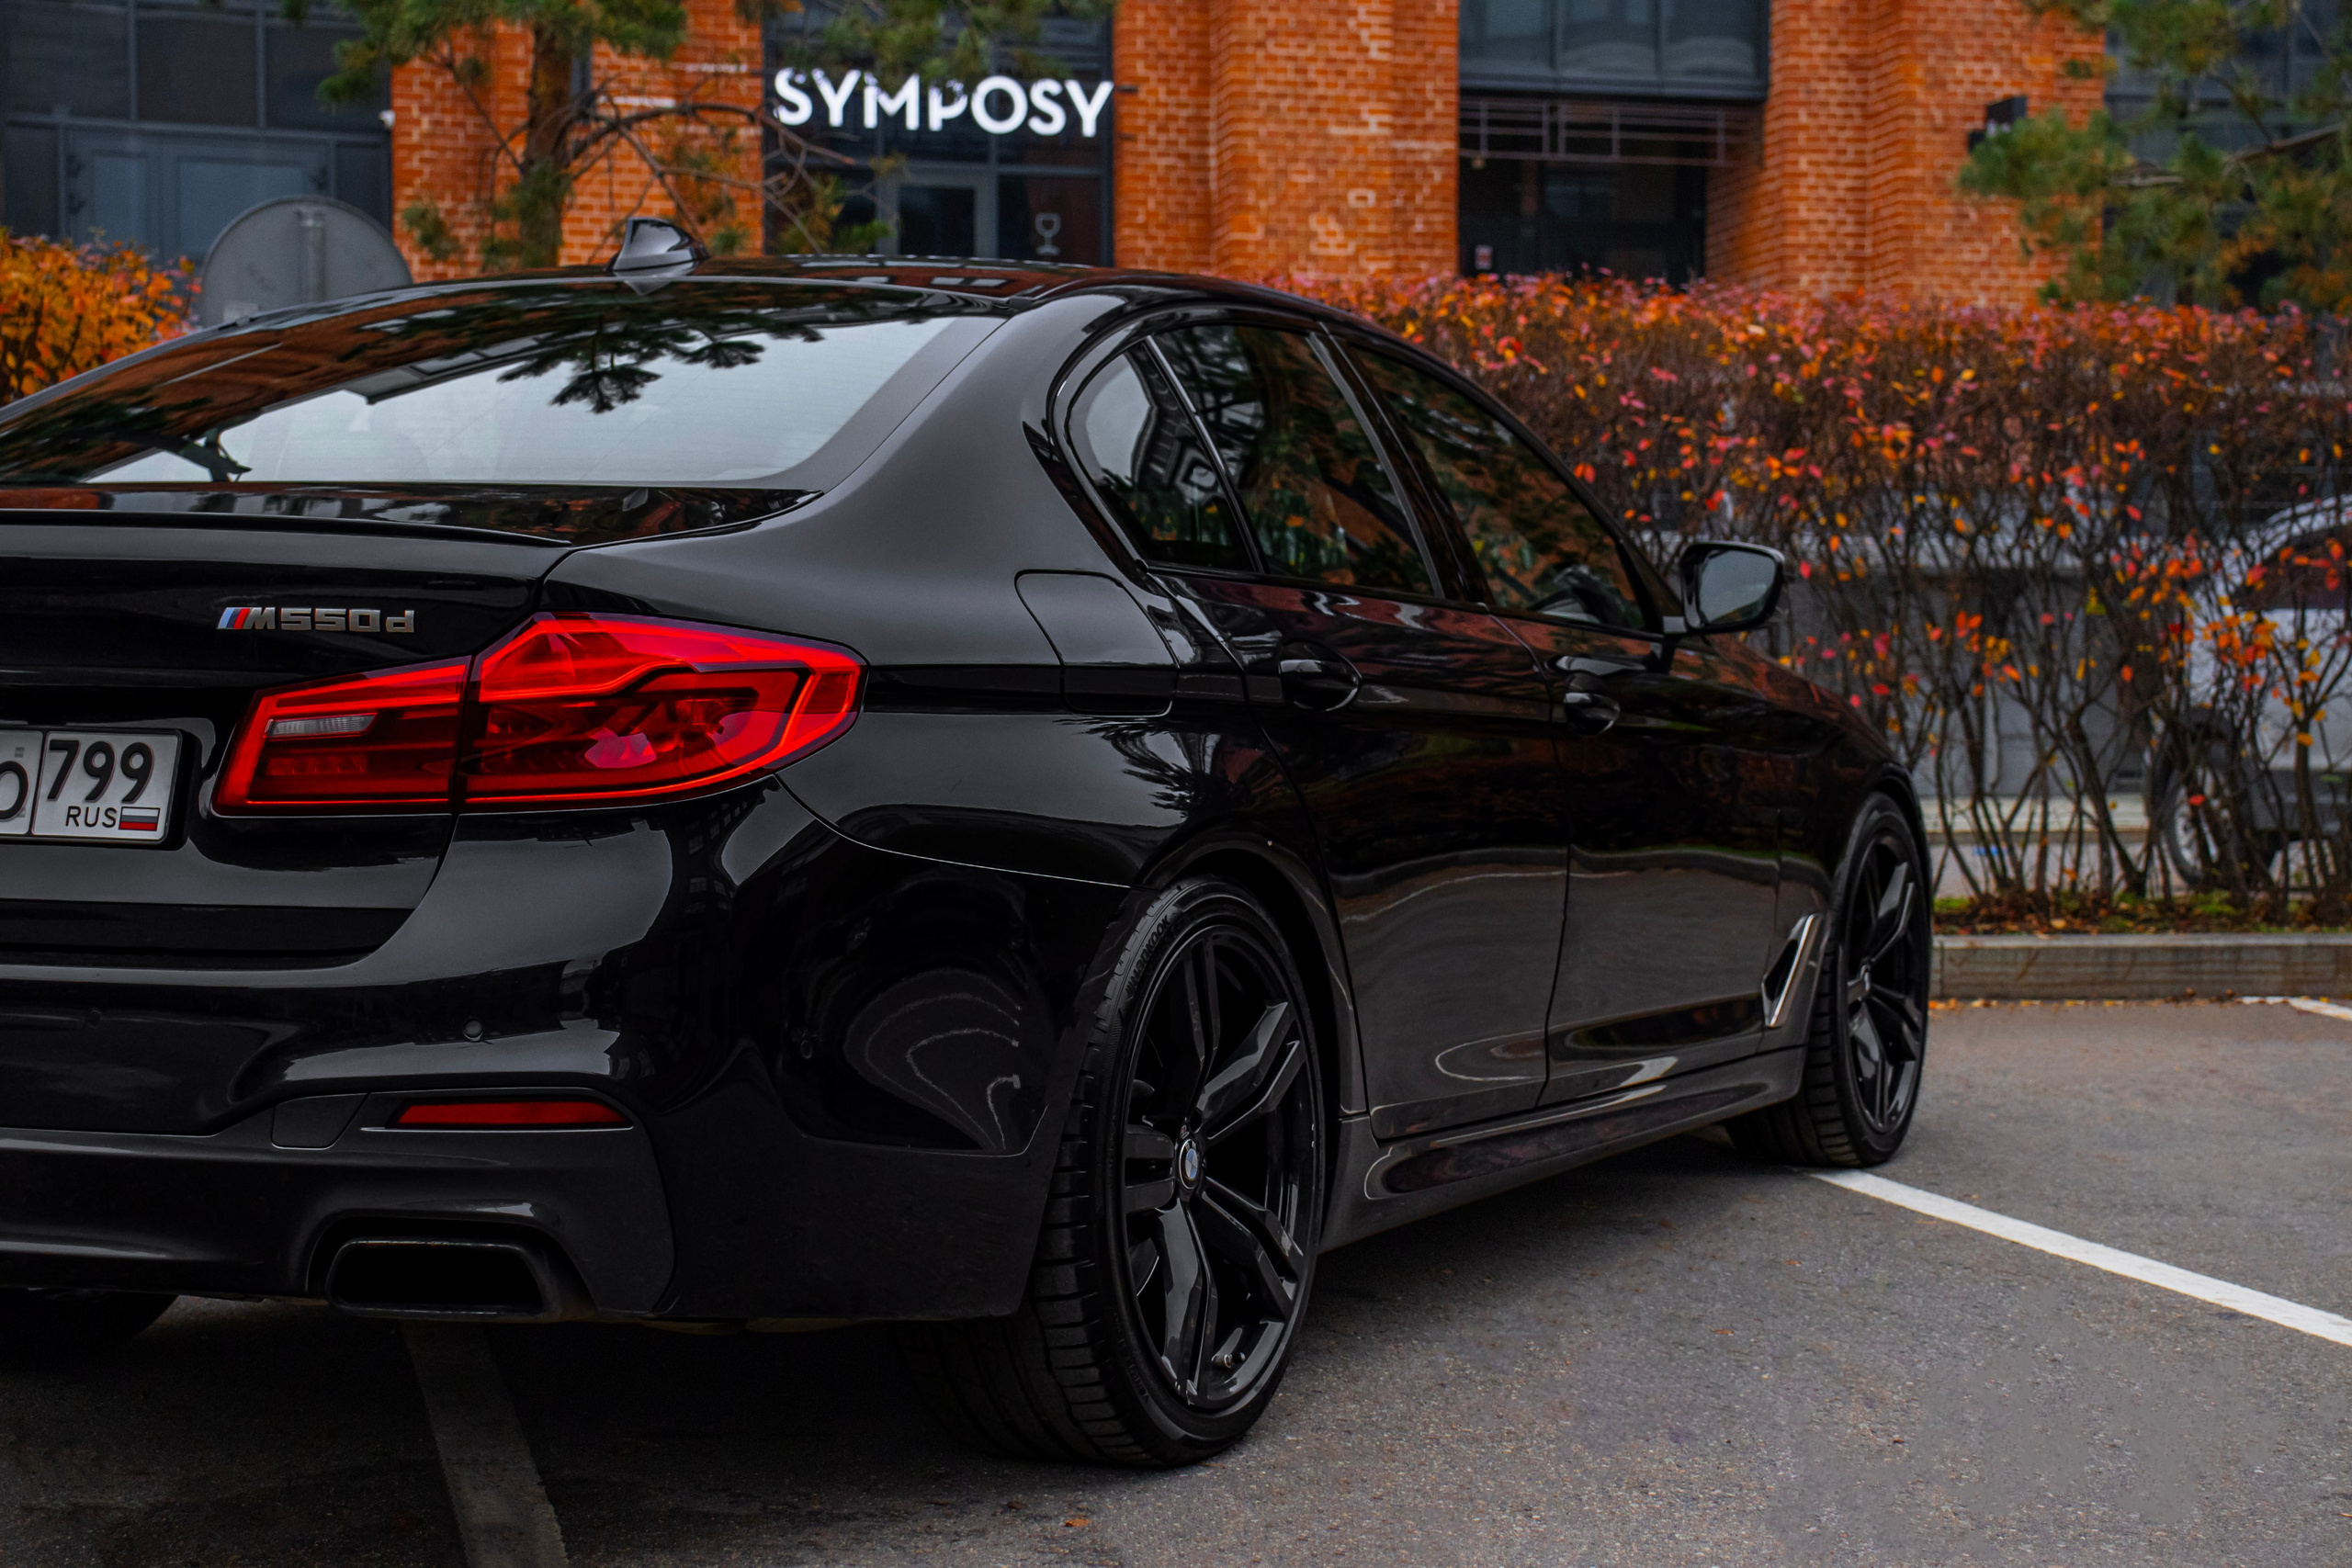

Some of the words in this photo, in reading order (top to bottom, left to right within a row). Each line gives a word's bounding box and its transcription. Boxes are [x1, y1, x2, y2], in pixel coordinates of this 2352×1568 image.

[774, 66, 1114, 137] SYMPOSY
[242, 606, 415, 633] M550d
[47, 739, 154, 804] 799
[65, 806, 118, 829] RUS
